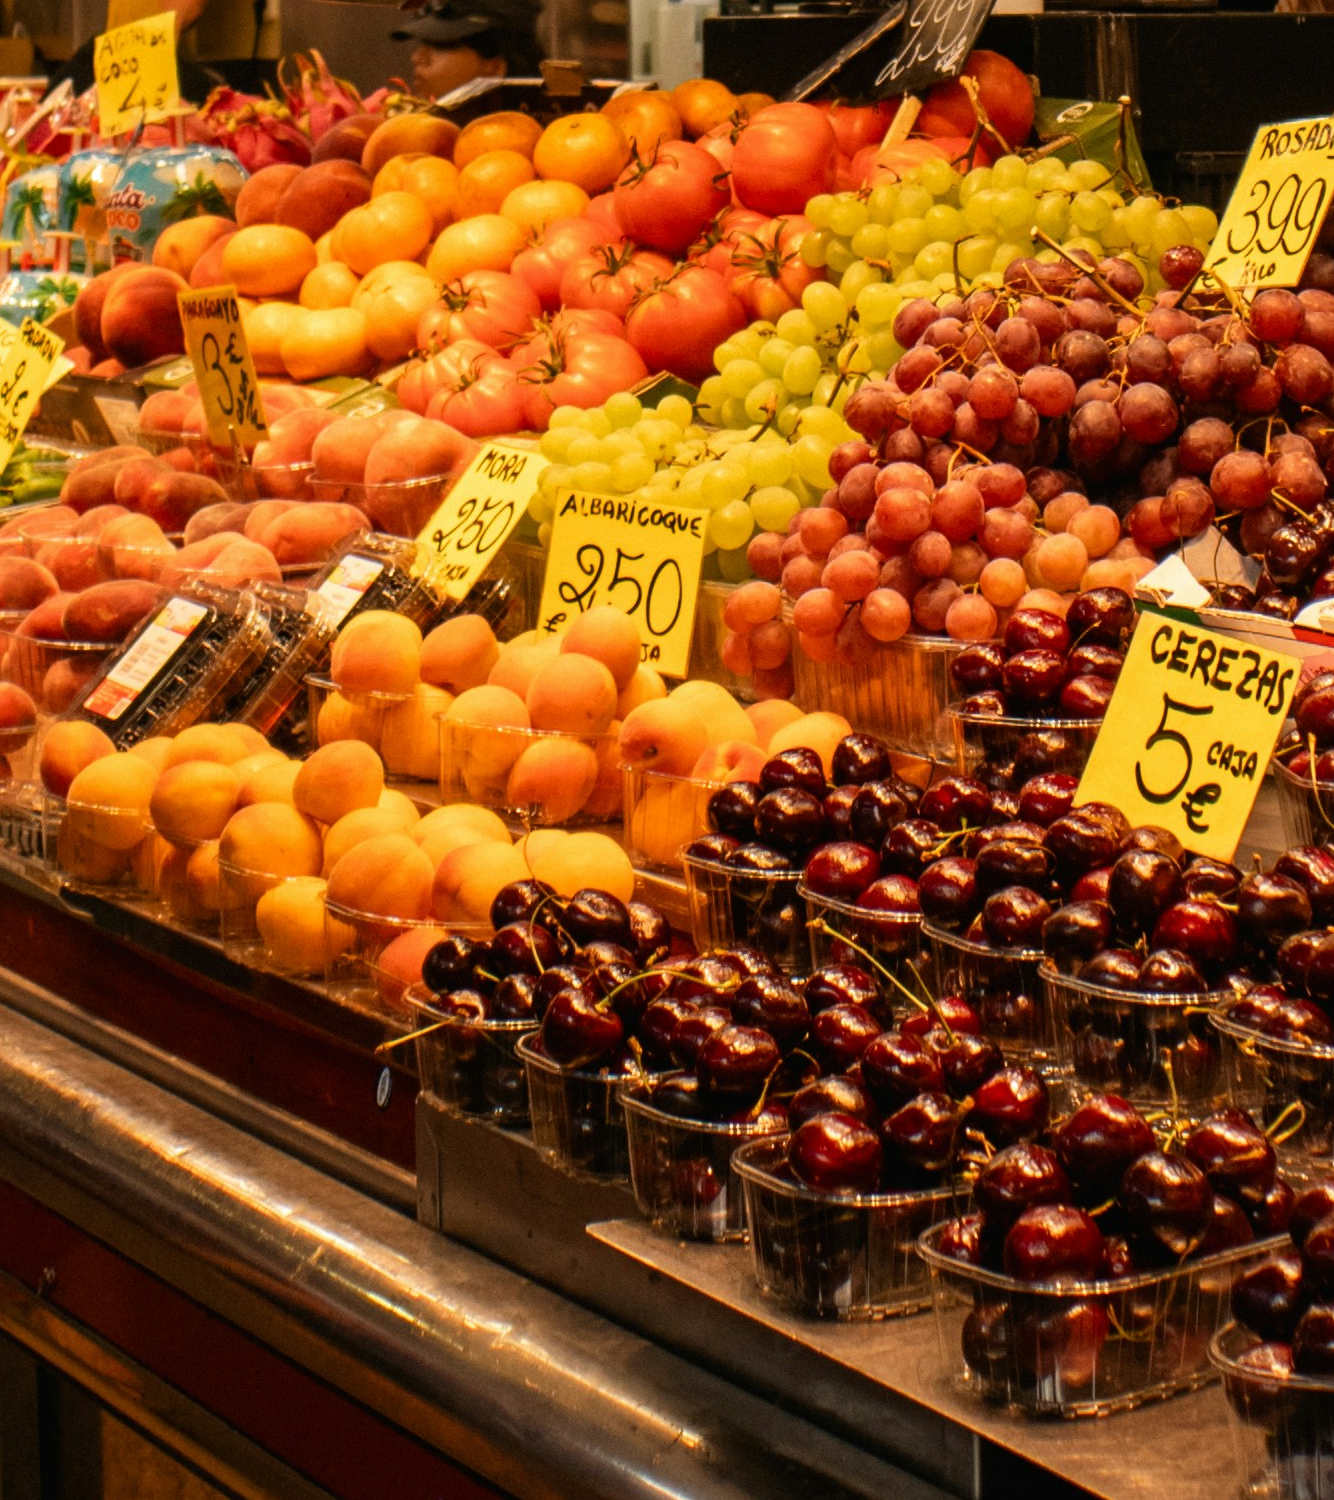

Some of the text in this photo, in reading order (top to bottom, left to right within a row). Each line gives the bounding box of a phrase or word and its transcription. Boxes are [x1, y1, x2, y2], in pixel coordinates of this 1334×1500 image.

[476, 448, 528, 485] MORA
[1150, 624, 1294, 716] CEREZAS
[1206, 741, 1259, 782] CAJA
